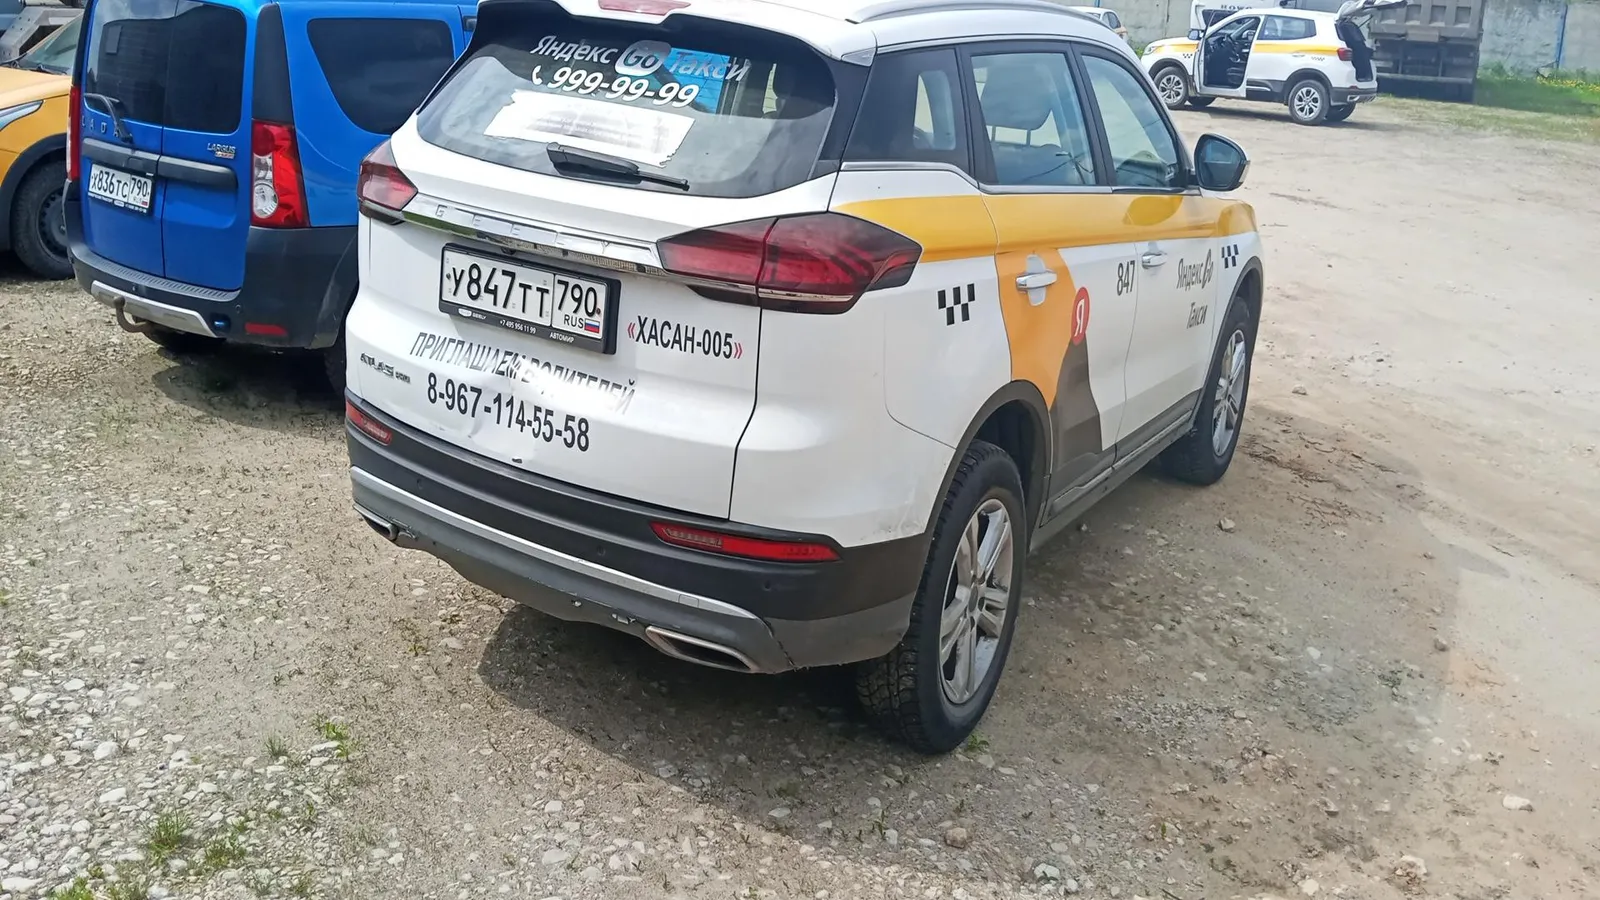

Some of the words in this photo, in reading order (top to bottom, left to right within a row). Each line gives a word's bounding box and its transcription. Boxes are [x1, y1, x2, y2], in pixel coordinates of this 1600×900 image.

[530, 36, 618, 63] Яндекс
[623, 46, 659, 69] Go
[668, 50, 750, 81] Такси
[547, 67, 699, 107] 999-99-99
[131, 177, 148, 197] 790
[1117, 260, 1136, 296] 847
[1176, 258, 1203, 291] Яндекс
[1201, 248, 1214, 289] Go
[557, 279, 598, 317] 790
[1186, 302, 1208, 329] Такси
[524, 325, 530, 333] 11
[564, 314, 584, 329] RUS
[1074, 299, 1085, 337] Я
[410, 331, 526, 379] ПРИГЛАШАЕМ
[549, 331, 574, 344] АВТОМИР
[627, 315, 743, 360] «ХАСАН-005»
[427, 372, 590, 452] 8-967-114-55-58
